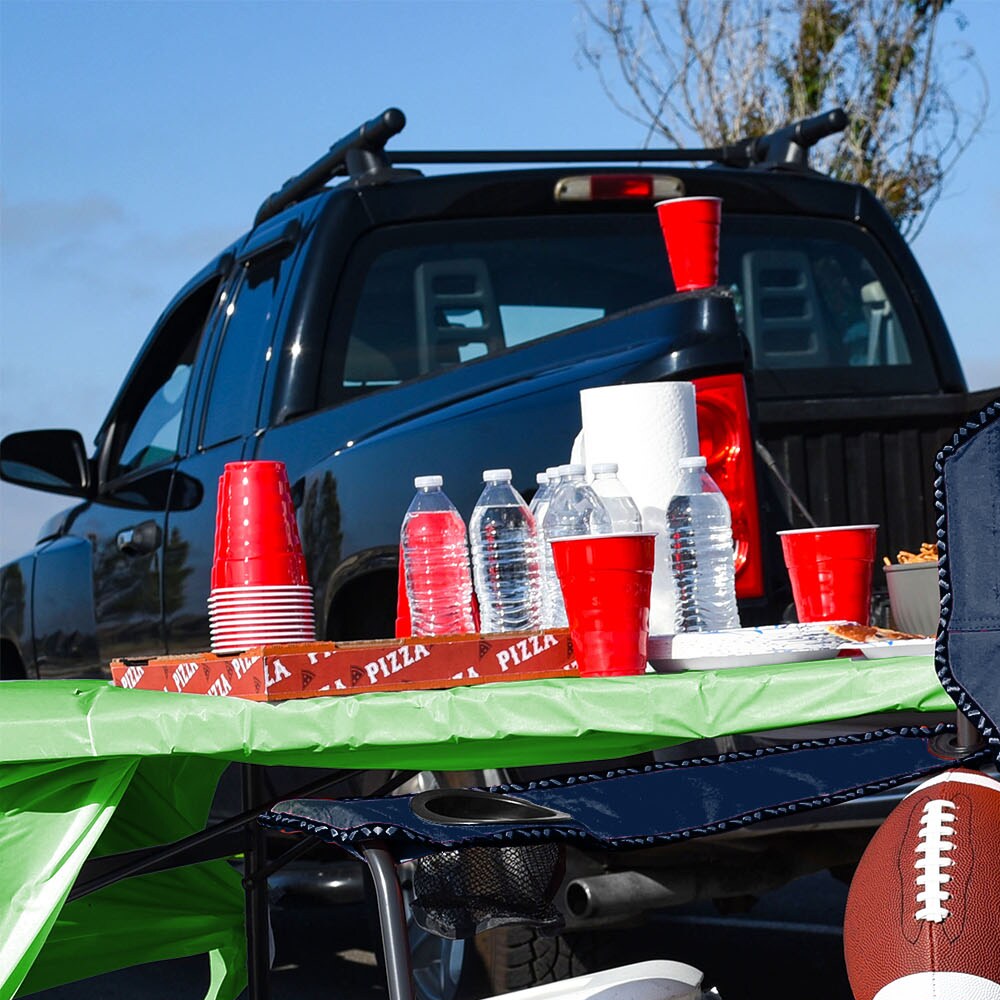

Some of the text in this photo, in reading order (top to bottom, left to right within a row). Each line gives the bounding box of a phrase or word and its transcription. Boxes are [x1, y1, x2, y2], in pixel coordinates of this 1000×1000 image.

[364, 644, 430, 684] PIZZA
[496, 634, 559, 672] PIZZA
[172, 662, 199, 693] PIZZA
